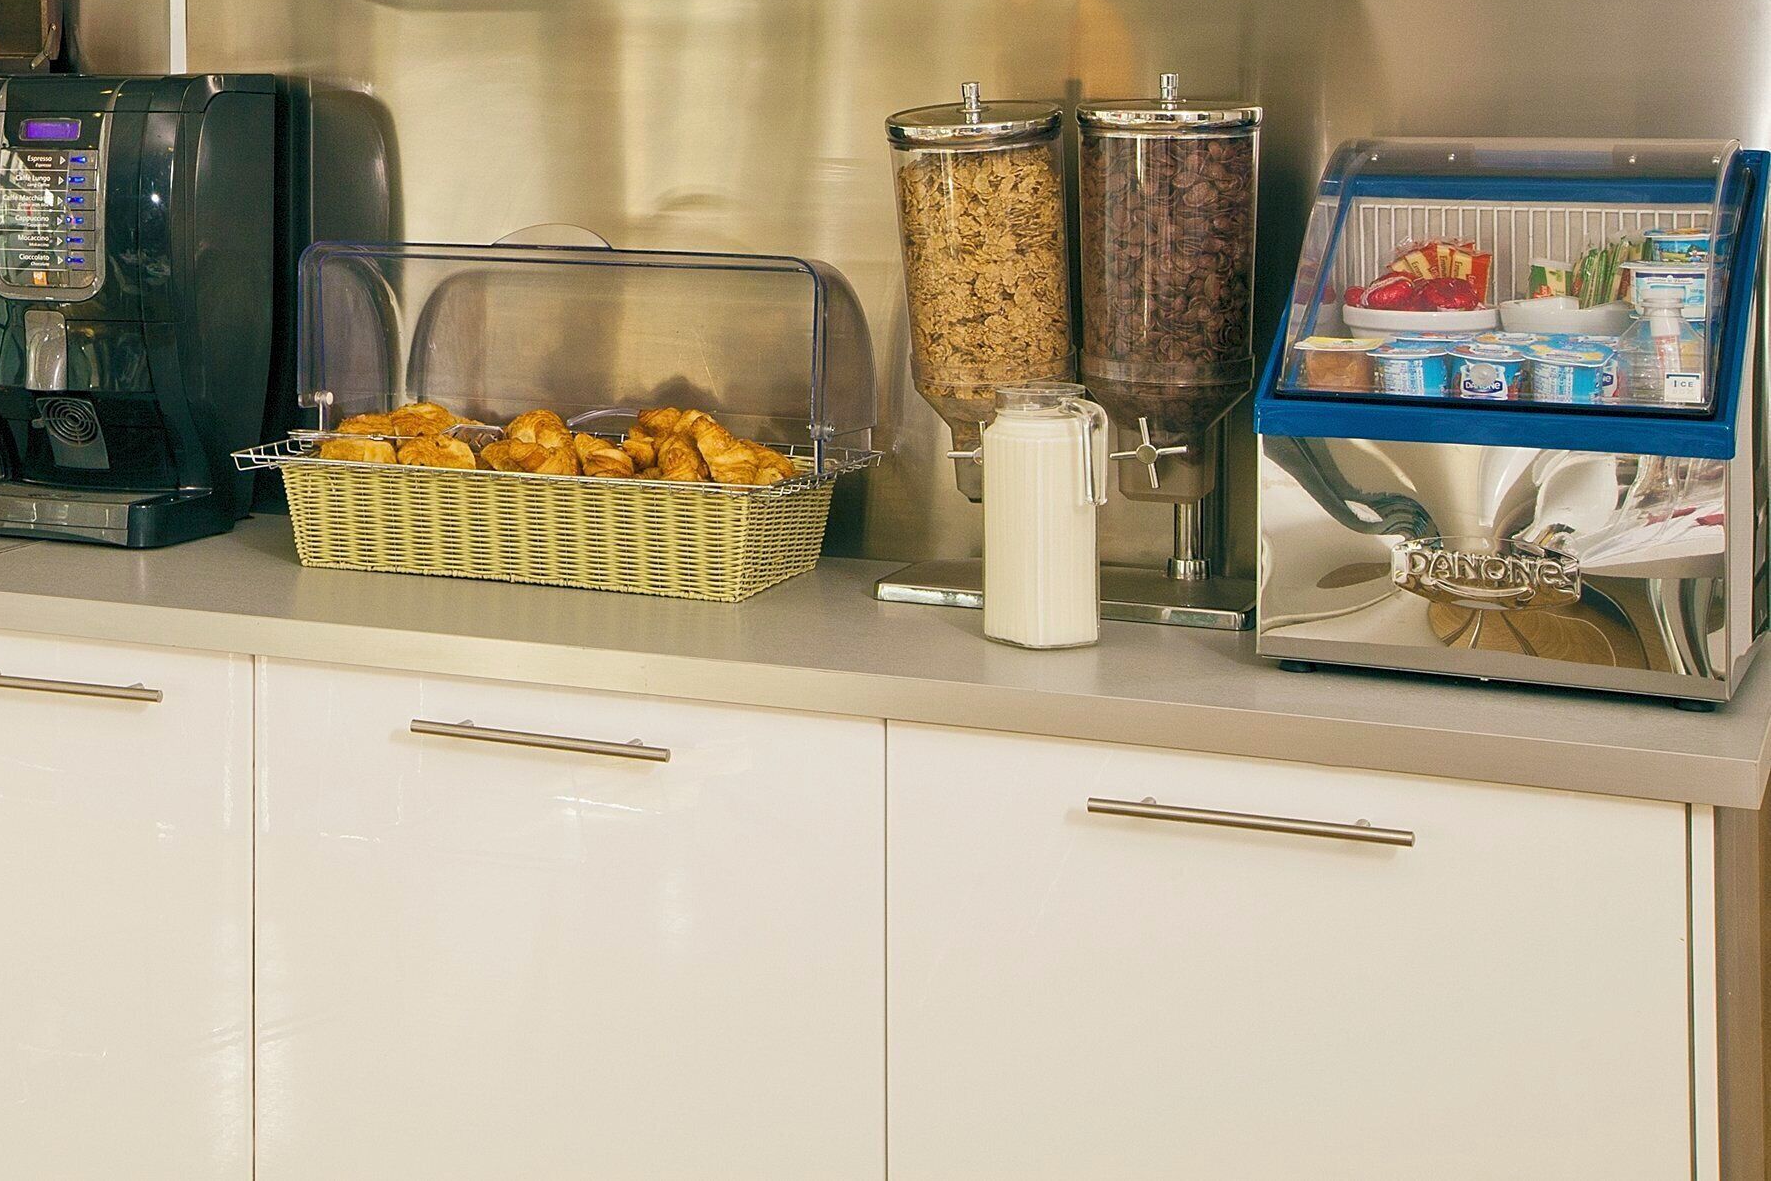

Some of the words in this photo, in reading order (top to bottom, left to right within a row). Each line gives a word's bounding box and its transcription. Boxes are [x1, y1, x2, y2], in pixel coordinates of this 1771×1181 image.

[27, 155, 52, 163] Espresso
[19, 253, 50, 261] Cioccolato
[1673, 379, 1694, 388] ICE
